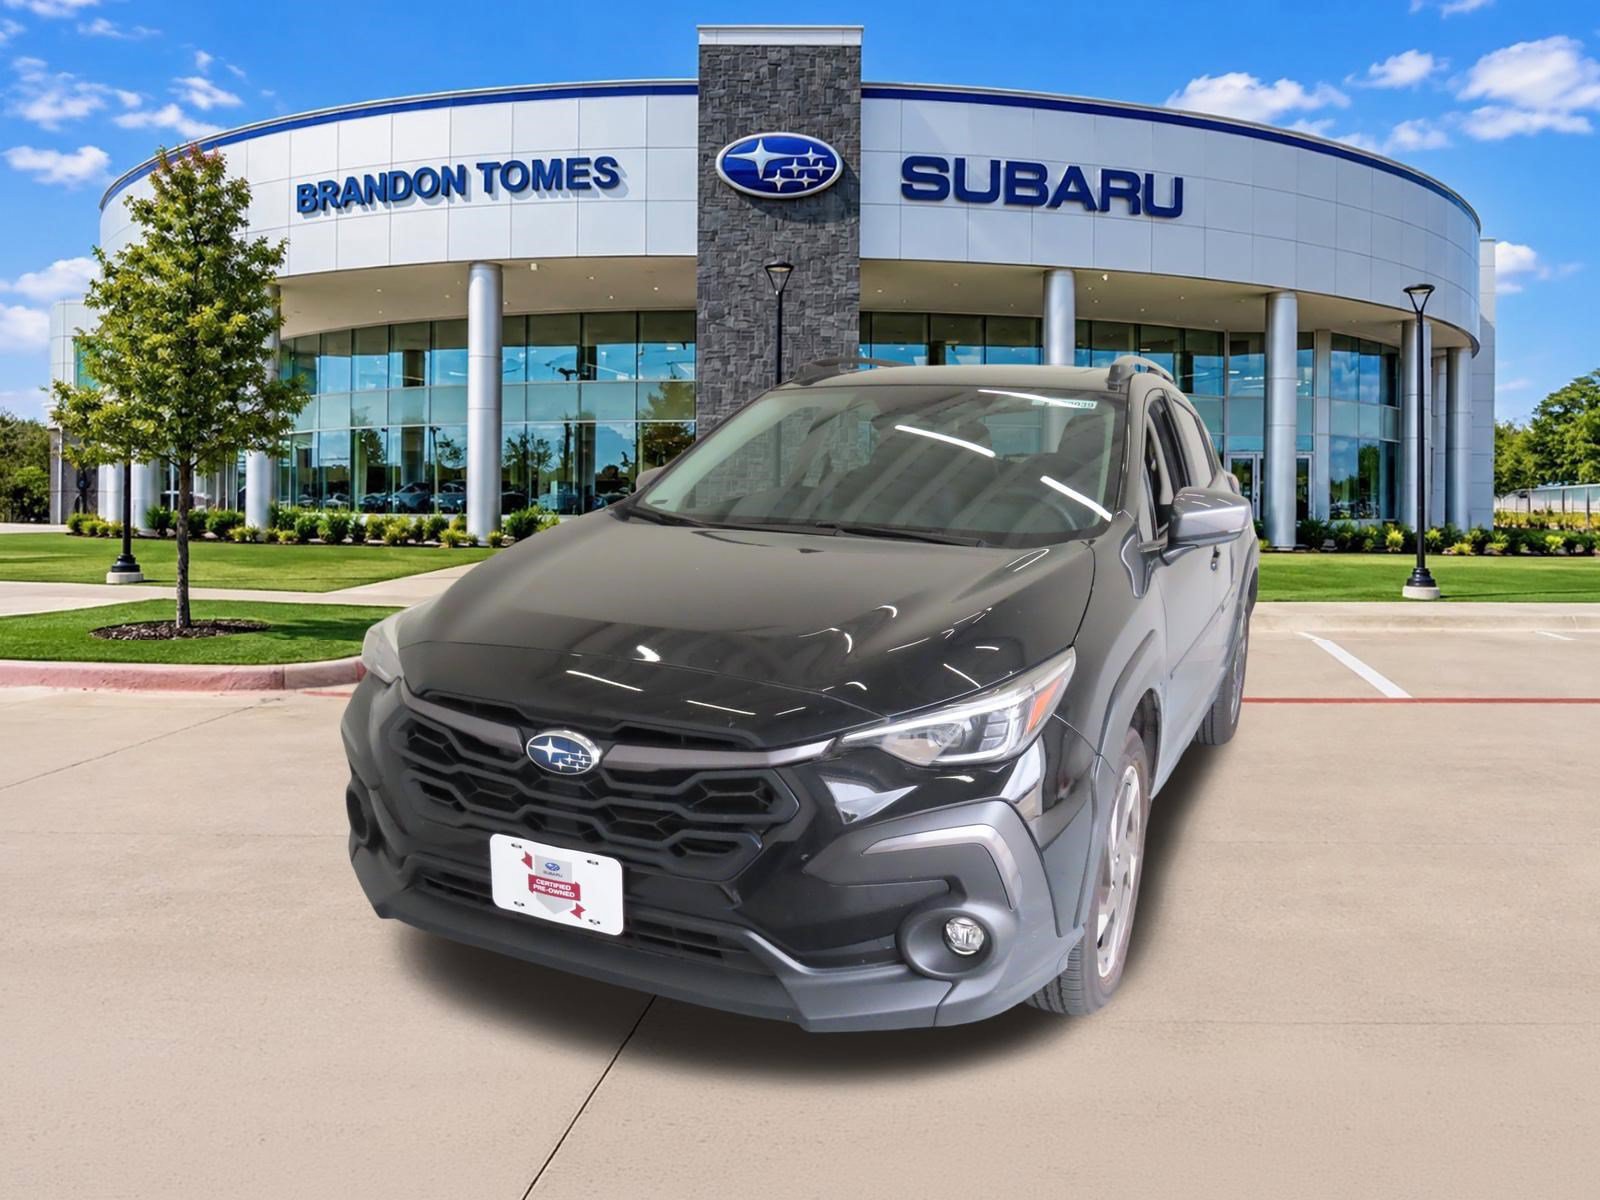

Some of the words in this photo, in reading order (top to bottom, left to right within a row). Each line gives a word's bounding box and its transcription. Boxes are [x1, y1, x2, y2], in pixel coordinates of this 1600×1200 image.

[296, 164, 467, 213] BRANDON
[476, 155, 620, 193] TOMES
[900, 155, 1184, 219] SUBARU
[533, 884, 576, 898] PRE-OWNED
[535, 879, 572, 891] CERTIFIED
